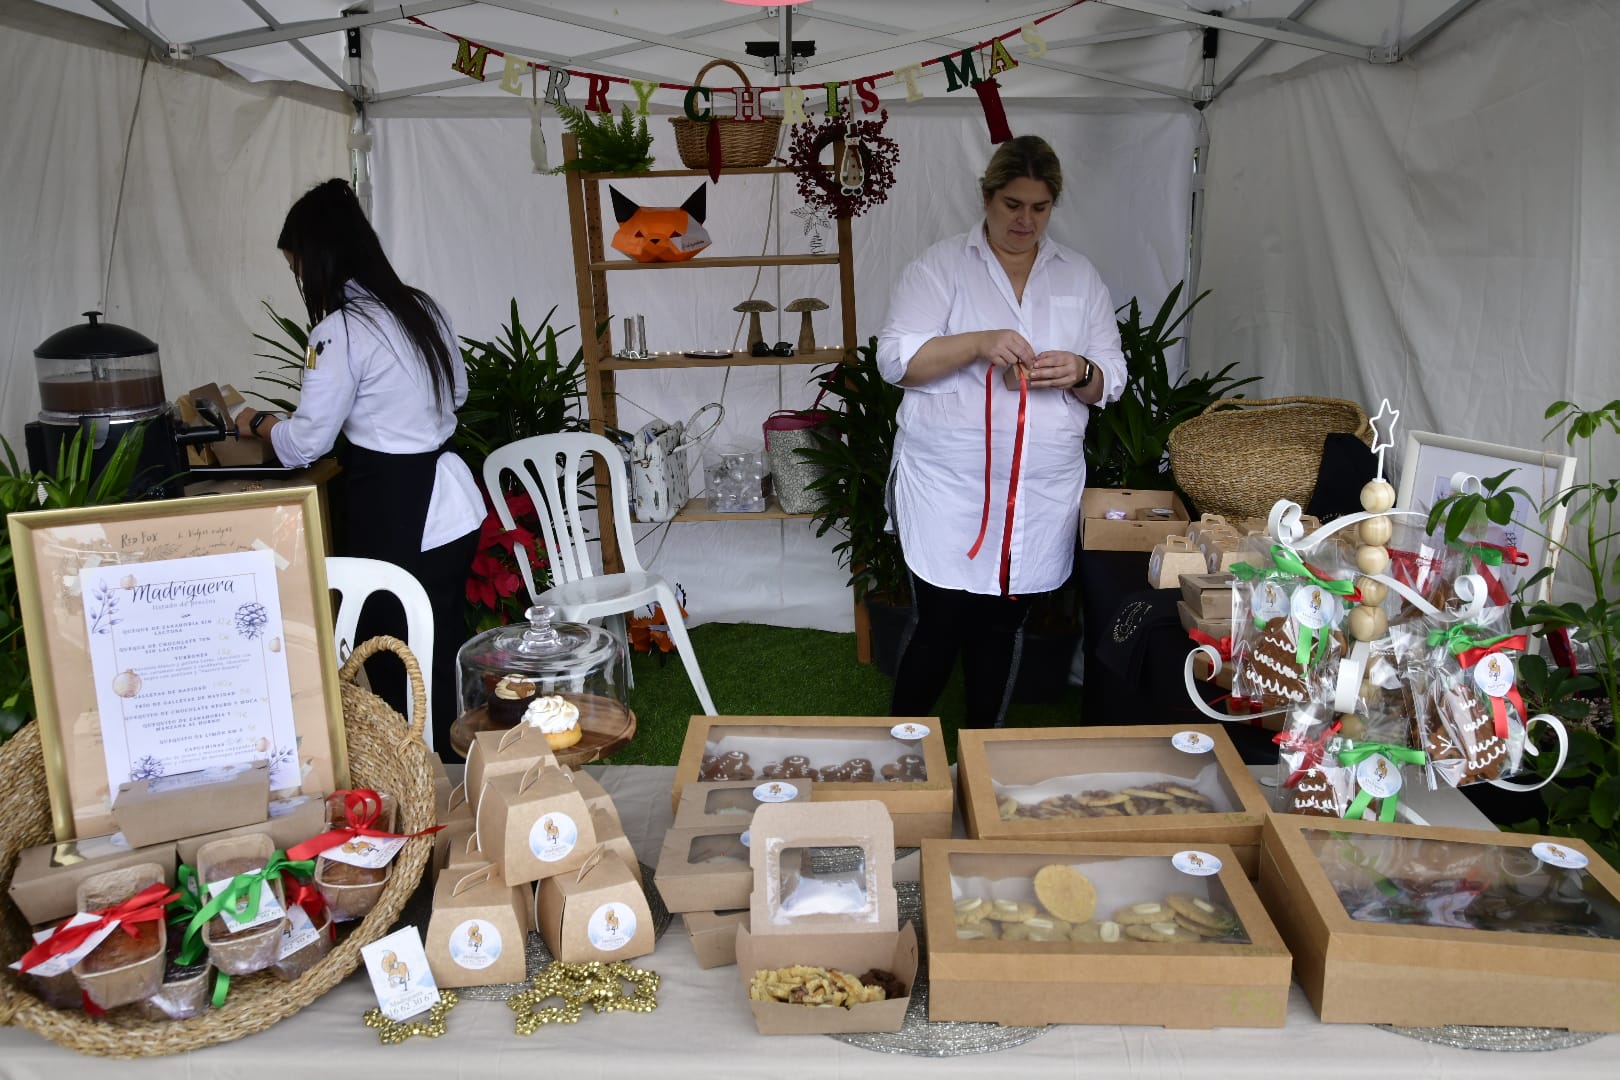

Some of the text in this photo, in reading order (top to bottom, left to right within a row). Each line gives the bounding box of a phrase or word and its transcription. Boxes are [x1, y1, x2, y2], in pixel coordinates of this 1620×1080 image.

[451, 21, 1047, 124] MERRY CHRISTMAS
[132, 580, 235, 603] Madriguera
